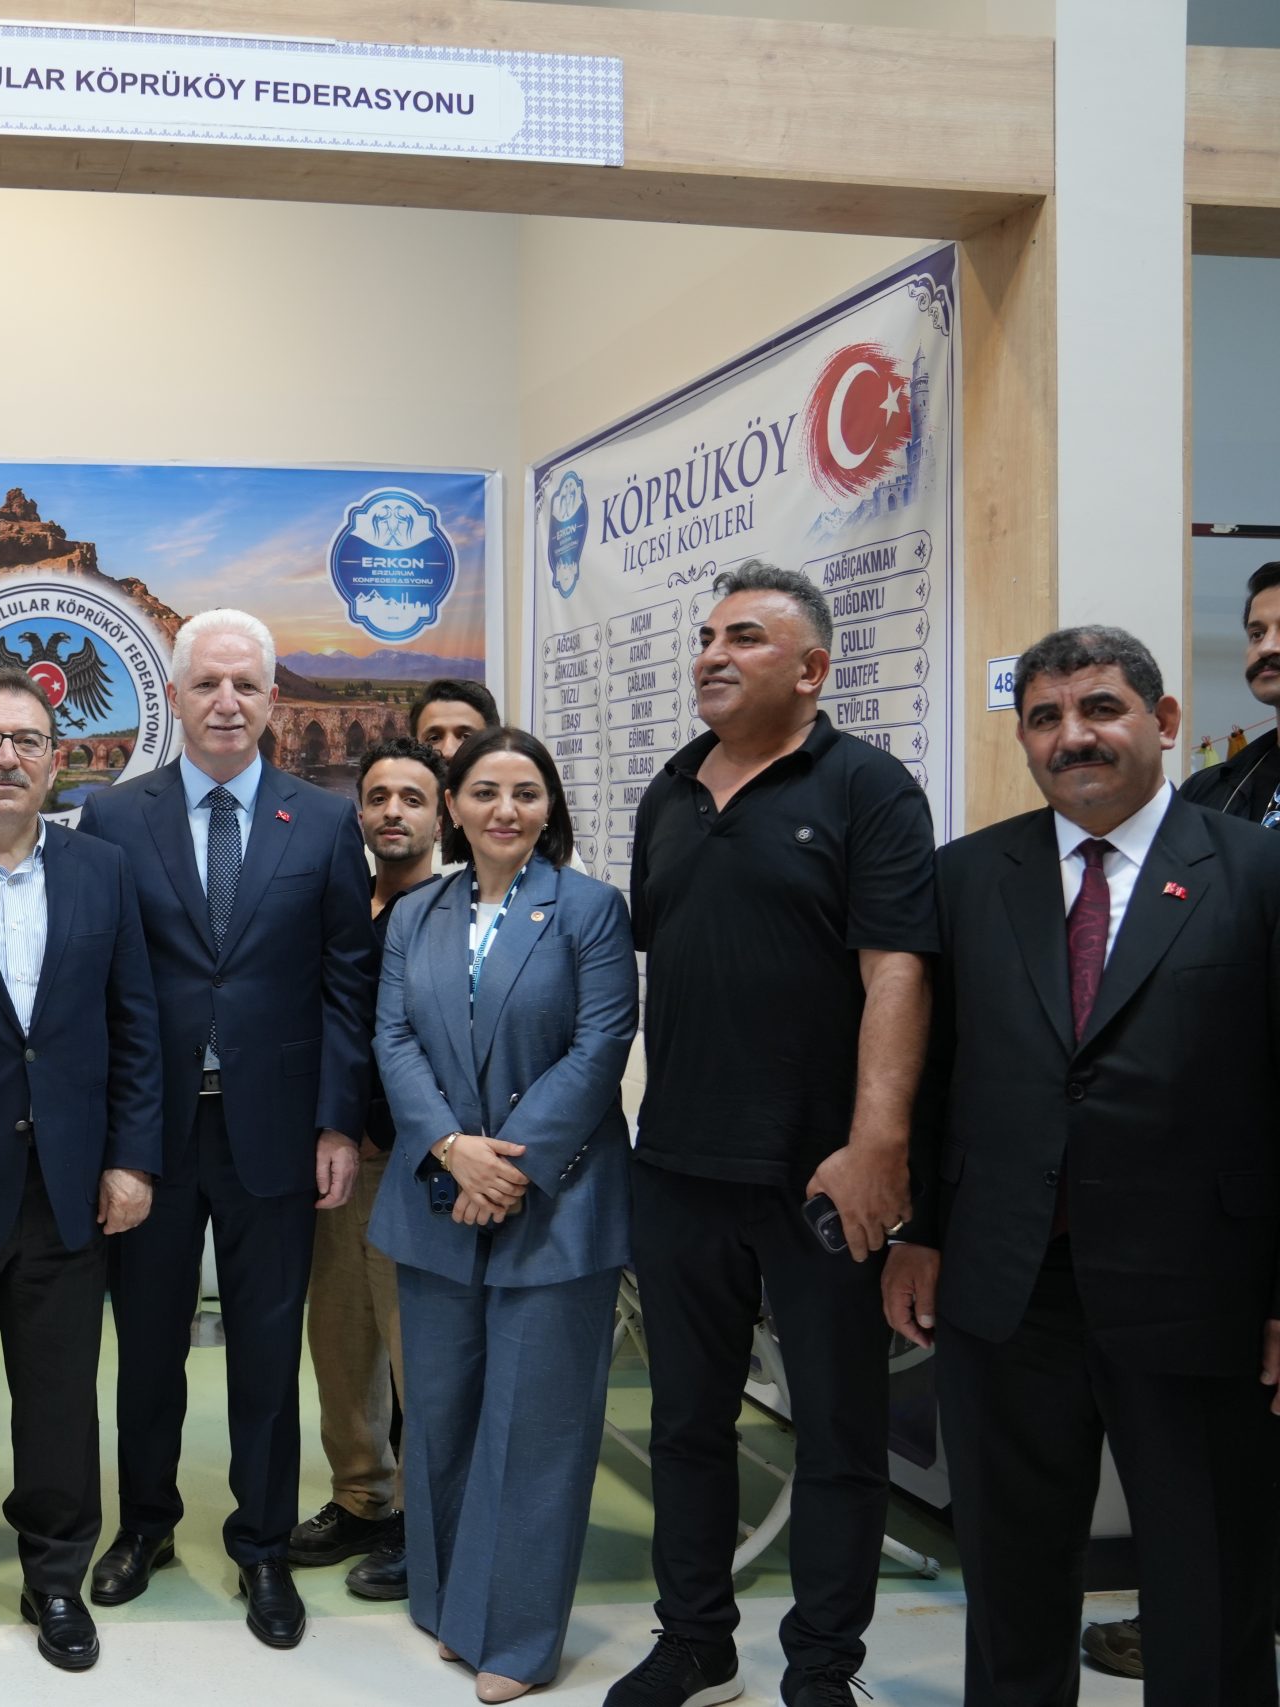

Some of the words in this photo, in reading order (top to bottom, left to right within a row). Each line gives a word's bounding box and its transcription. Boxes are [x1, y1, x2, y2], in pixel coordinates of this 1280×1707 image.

[76, 67, 246, 100] KÖPRÜKÖY
[255, 81, 475, 115] FEDERASYONU
[600, 413, 798, 544] KÖPRÜKÖY
[623, 526, 671, 575] İLÇESİ
[677, 494, 755, 554] KÖYLERİ
[362, 557, 424, 569] ERKON
[822, 546, 898, 587] AŞAĞIÇAKMAK
[353, 577, 433, 585] KONFEDERASYONU
[833, 586, 885, 618] BUĞDAYLI
[631, 613, 652, 635] AKÇAM
[629, 640, 652, 663] ATAKÖY
[841, 627, 876, 657] ÇULLU
[56, 599, 129, 645] KÖPRÜKÖY
[124, 644, 160, 755] FEDERASYONU
[627, 671, 656, 696] ÇAĞLAYAN
[835, 662, 879, 690] DUATEPE
[631, 700, 653, 721] DİKYAR
[837, 698, 880, 725] EYÜPLER
[628, 728, 655, 749] EĞİRMEZ
[628, 754, 654, 777] GÖLBAŞI
